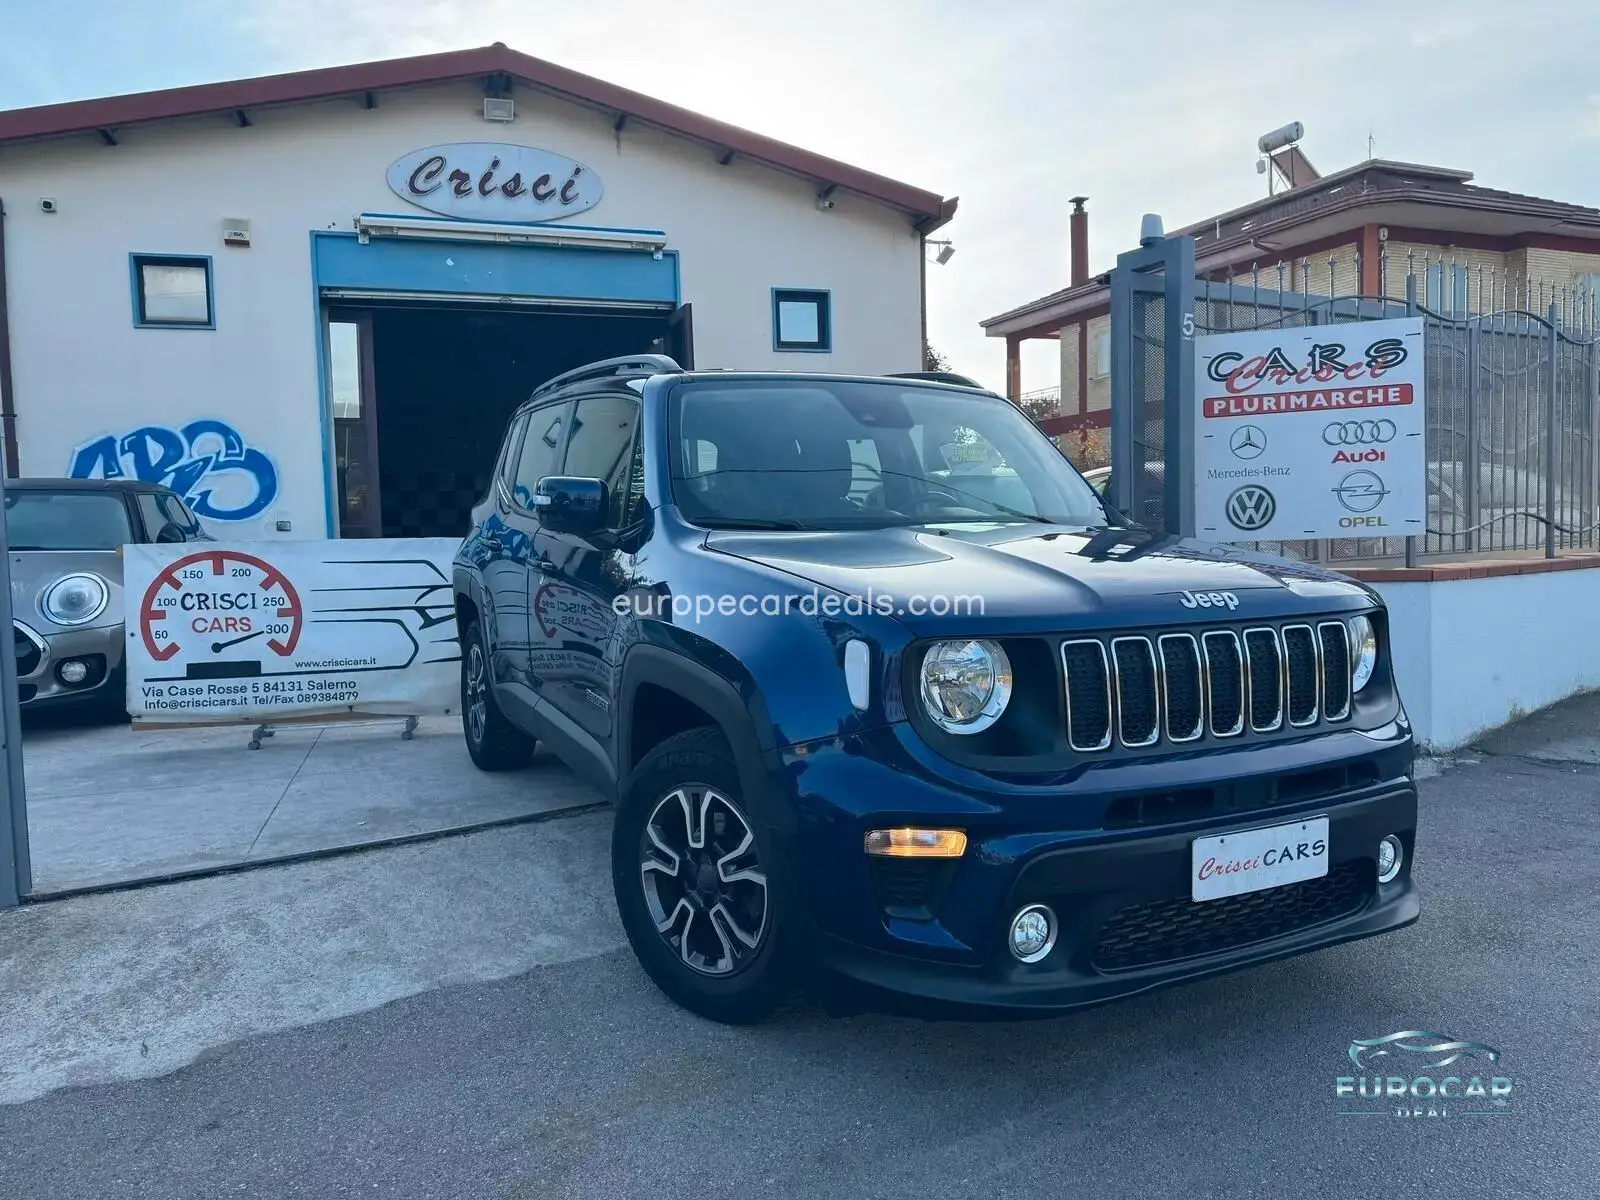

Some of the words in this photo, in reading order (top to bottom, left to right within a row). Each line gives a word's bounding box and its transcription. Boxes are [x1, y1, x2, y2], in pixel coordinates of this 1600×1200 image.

[408, 154, 580, 205] Crisci
[1182, 312, 1195, 337] 5
[1207, 338, 1408, 383] CARS
[1225, 355, 1390, 394] Crisci
[1212, 386, 1401, 415] PLURIMARCHE
[1331, 448, 1386, 464] Audi
[1207, 466, 1291, 480] Mercedes-Benz
[1338, 515, 1389, 528] OPEL
[182, 570, 204, 579] 150
[231, 568, 251, 577] 200
[156, 598, 177, 607] 100
[180, 592, 258, 611] CRISCI
[262, 597, 285, 607] 250
[1179, 590, 1240, 611] Jeep
[191, 616, 252, 633] CARS
[265, 624, 289, 634] 300
[154, 630, 169, 639] 50
[295, 657, 377, 668] www.criscicars.it
[141, 686, 164, 698] Via
[168, 685, 204, 697] Case
[207, 683, 248, 696] Rosse
[251, 682, 260, 693] 5
[263, 681, 303, 693] 84131
[307, 679, 357, 691] Salerno
[144, 696, 248, 710] Info@criscicars.it
[253, 694, 295, 706] Tel/Fax
[297, 690, 360, 704] 089384879
